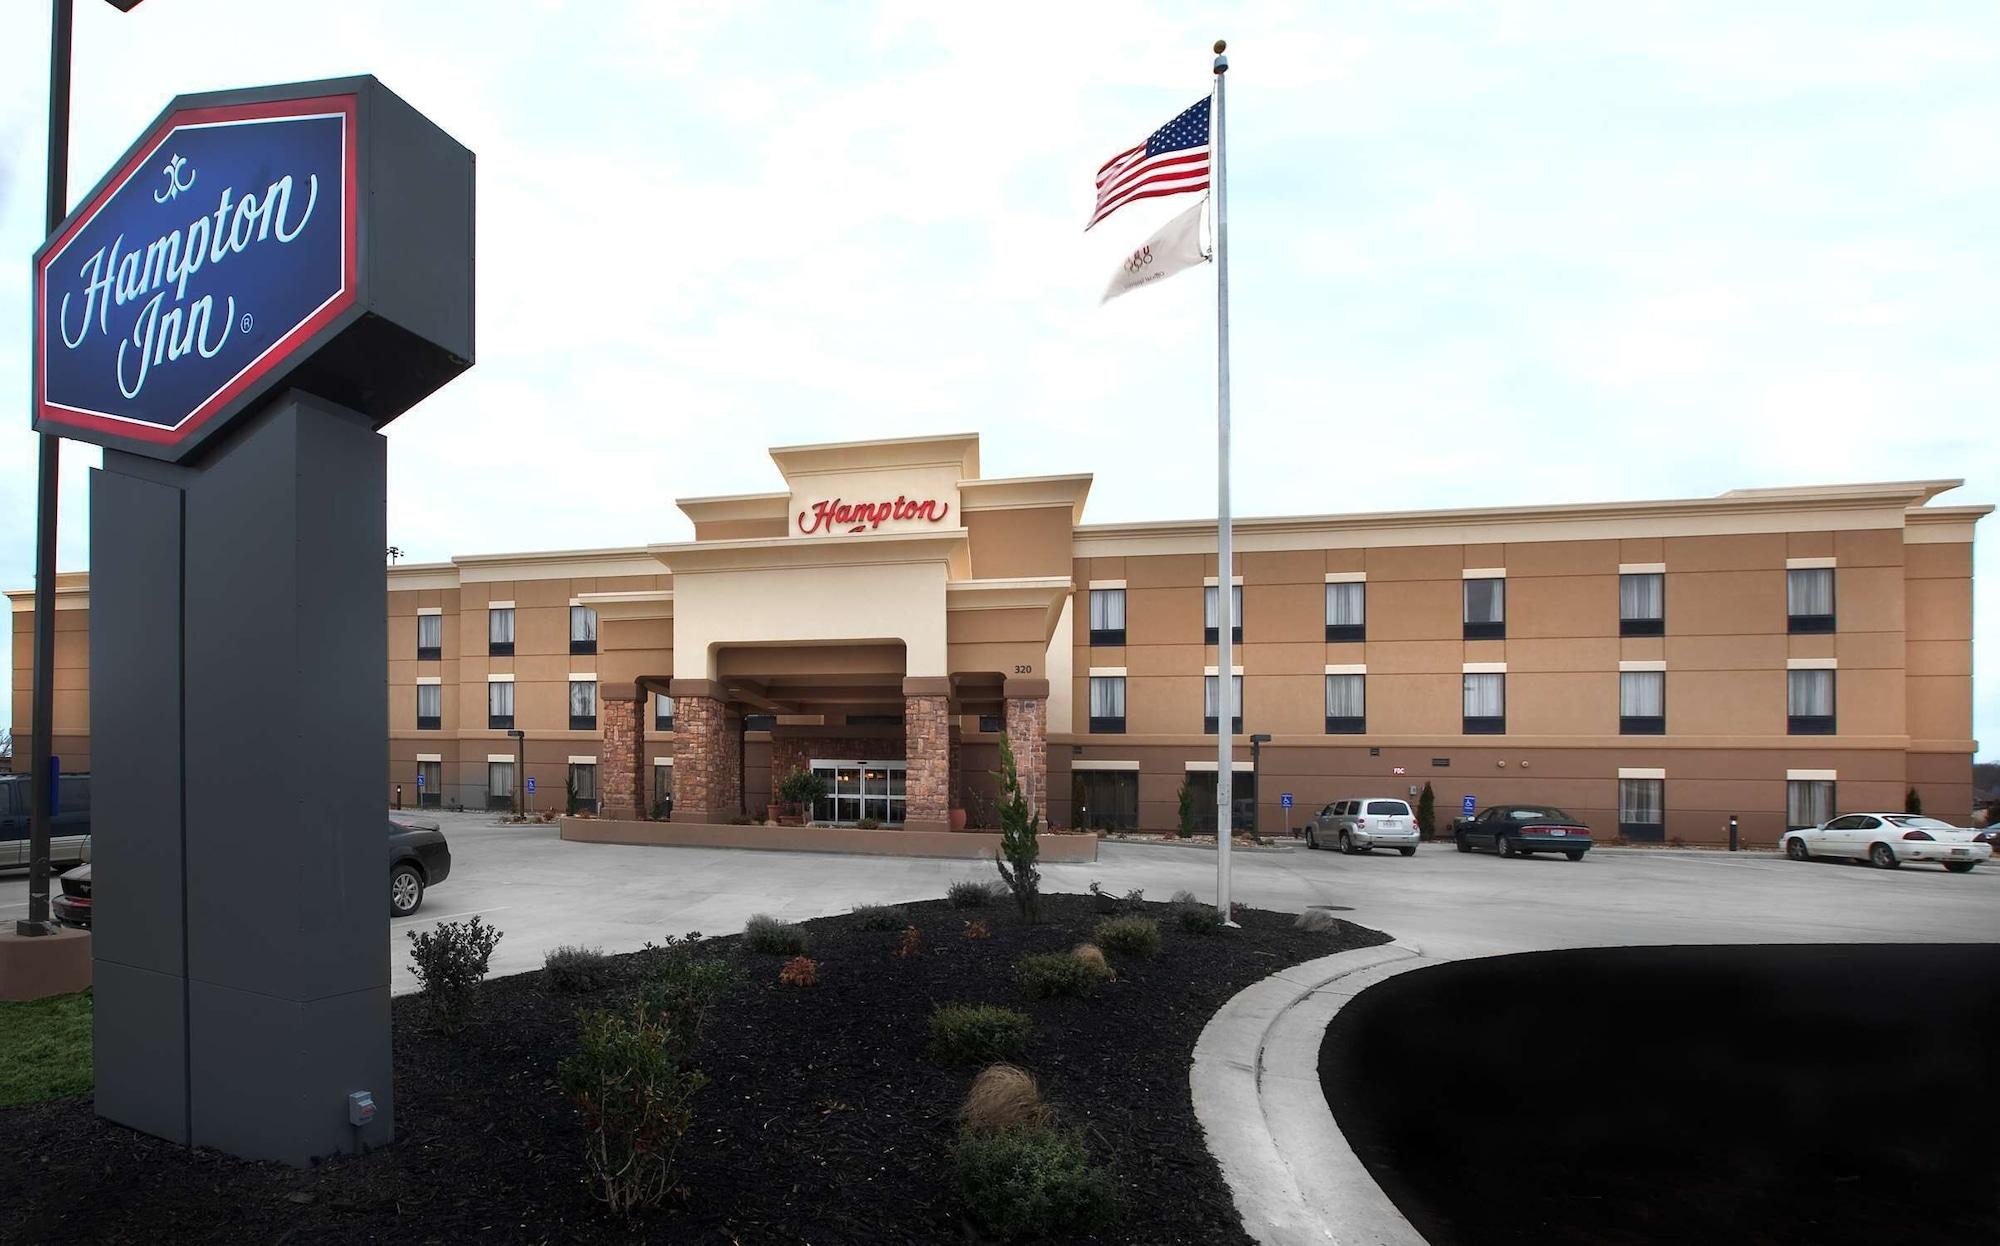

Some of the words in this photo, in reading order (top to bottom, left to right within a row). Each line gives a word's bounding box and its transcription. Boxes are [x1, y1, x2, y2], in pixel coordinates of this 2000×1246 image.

[61, 173, 318, 349] Hampton
[117, 290, 235, 399] Inn
[798, 495, 948, 535] Hampton
[1014, 665, 1032, 674] 320
